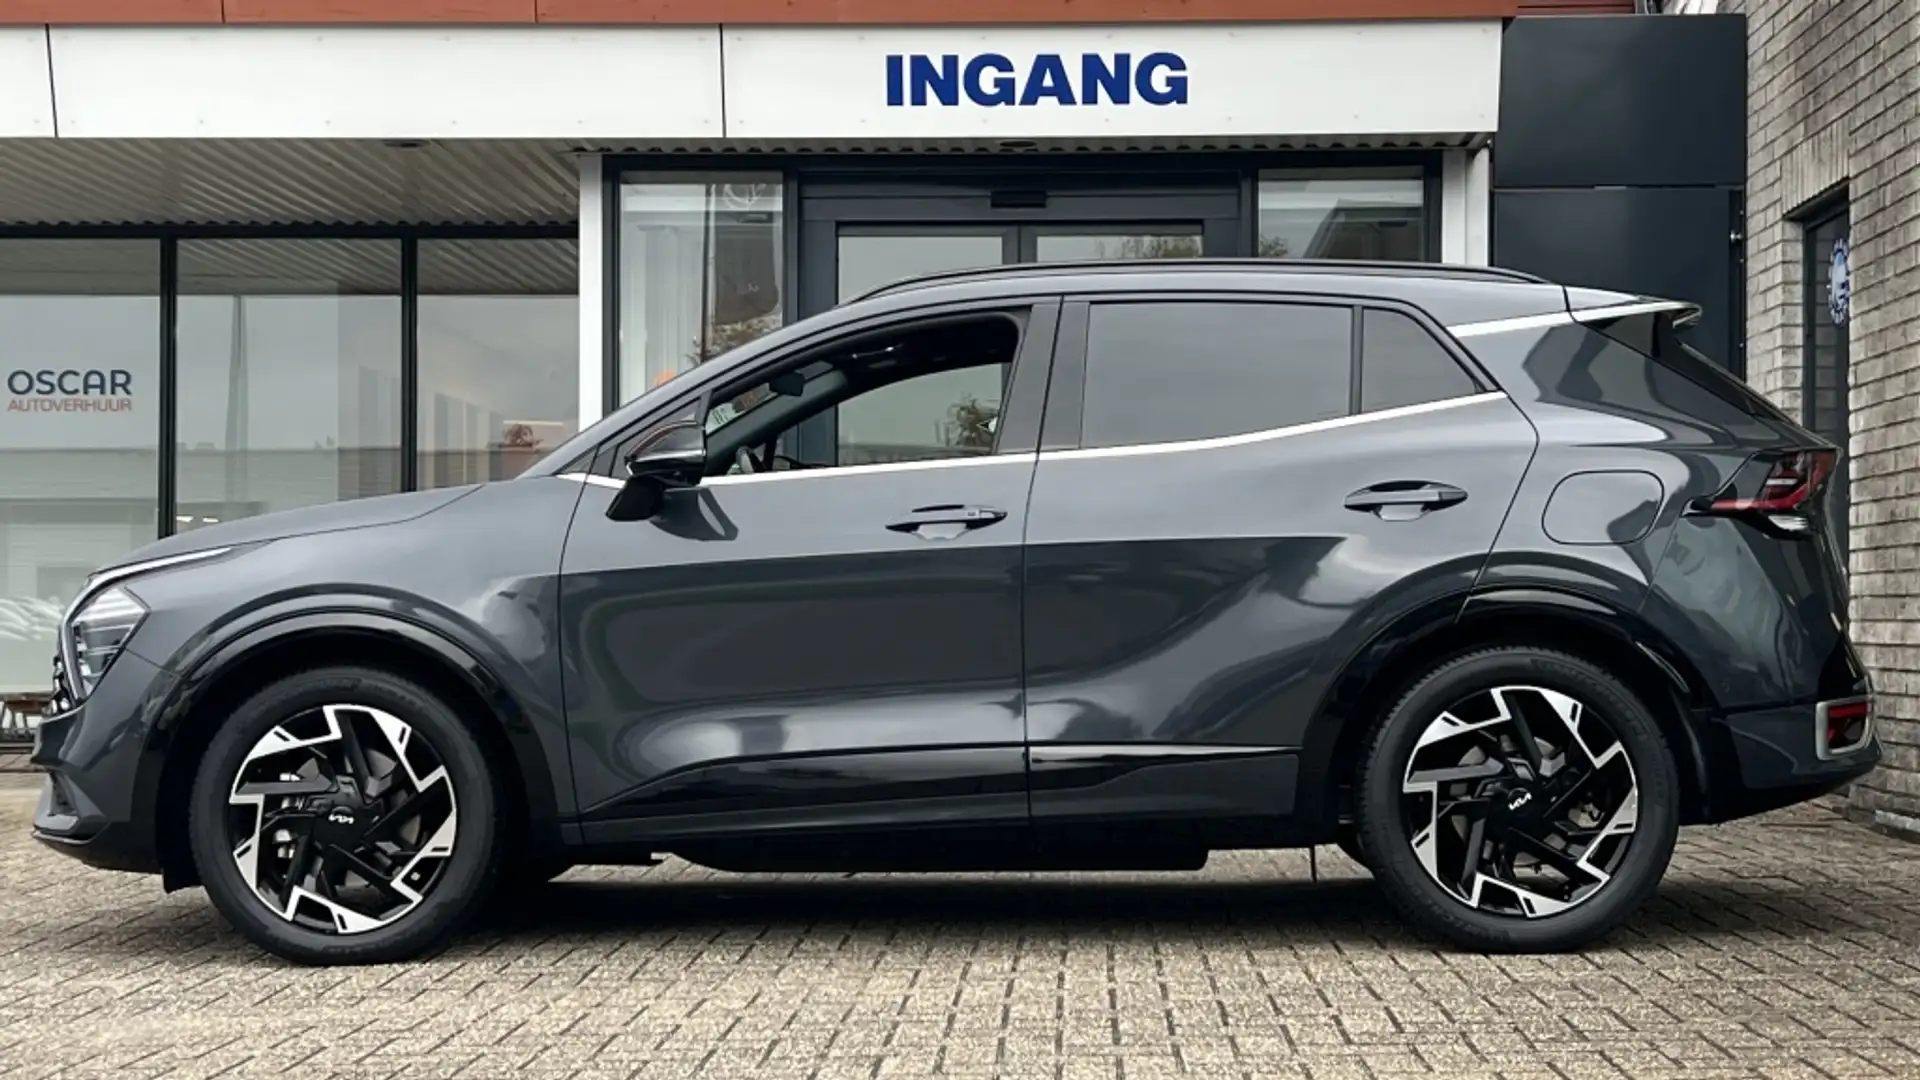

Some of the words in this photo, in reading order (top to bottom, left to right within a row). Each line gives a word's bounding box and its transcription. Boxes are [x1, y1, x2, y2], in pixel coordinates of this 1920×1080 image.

[886, 52, 1188, 107] INGANG
[7, 369, 133, 395] OSCAR
[7, 398, 133, 413] AUTOVERHUUR
